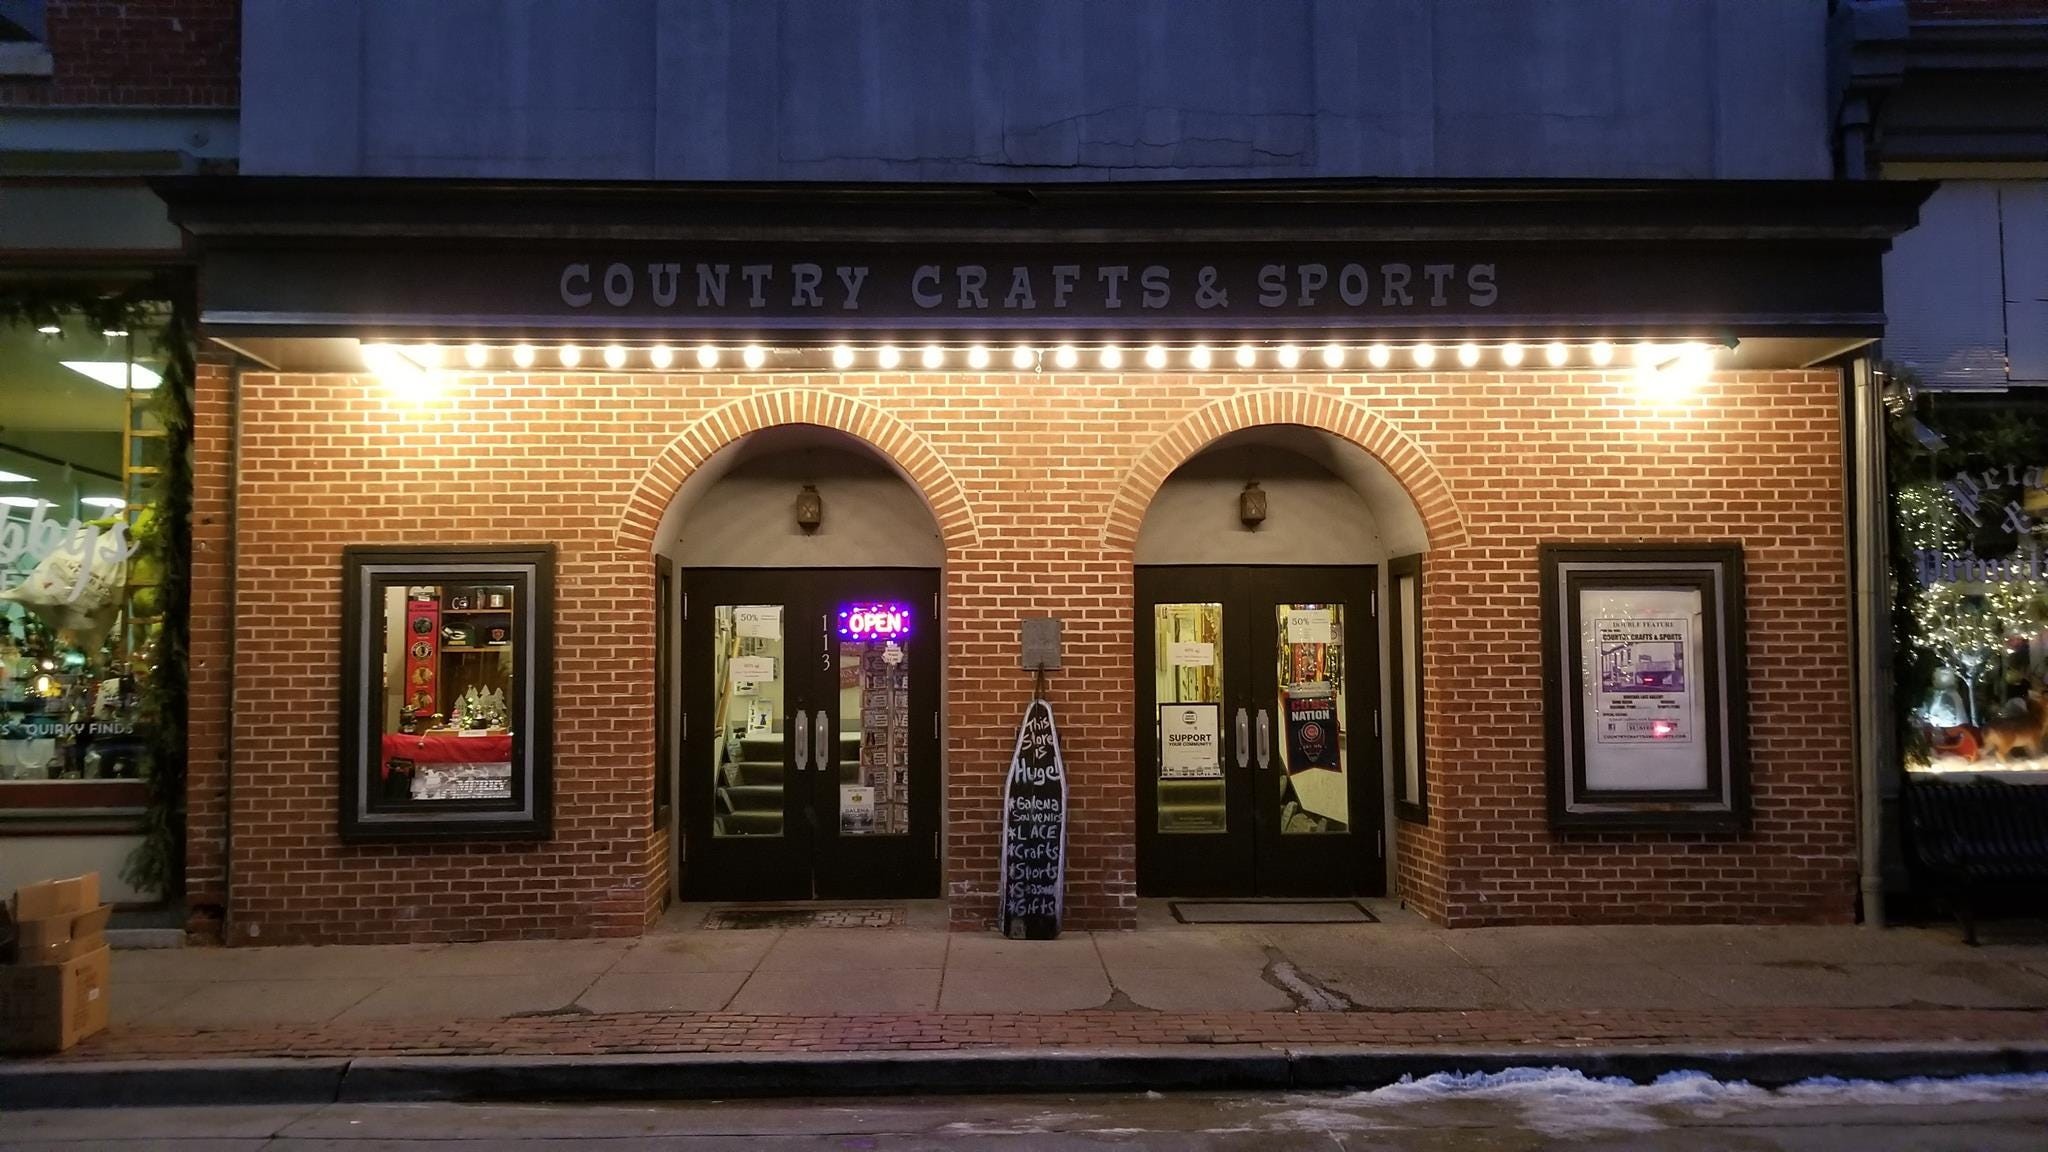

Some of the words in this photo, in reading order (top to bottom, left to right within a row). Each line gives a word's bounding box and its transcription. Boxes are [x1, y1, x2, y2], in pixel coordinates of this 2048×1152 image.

[560, 262, 869, 309] COUNTRY
[911, 264, 1171, 309] CRAFTS
[1195, 265, 1228, 309] &
[1257, 263, 1499, 308] SPORTS
[849, 612, 902, 633] OPEN
[1659, 633, 1683, 641] SPORTS
[1291, 710, 1330, 721] NATION
[25, 723, 85, 737] QUIRKY
[89, 723, 134, 735] FINDS
[1026, 716, 1050, 733] This
[1168, 734, 1212, 742] SUPPORT
